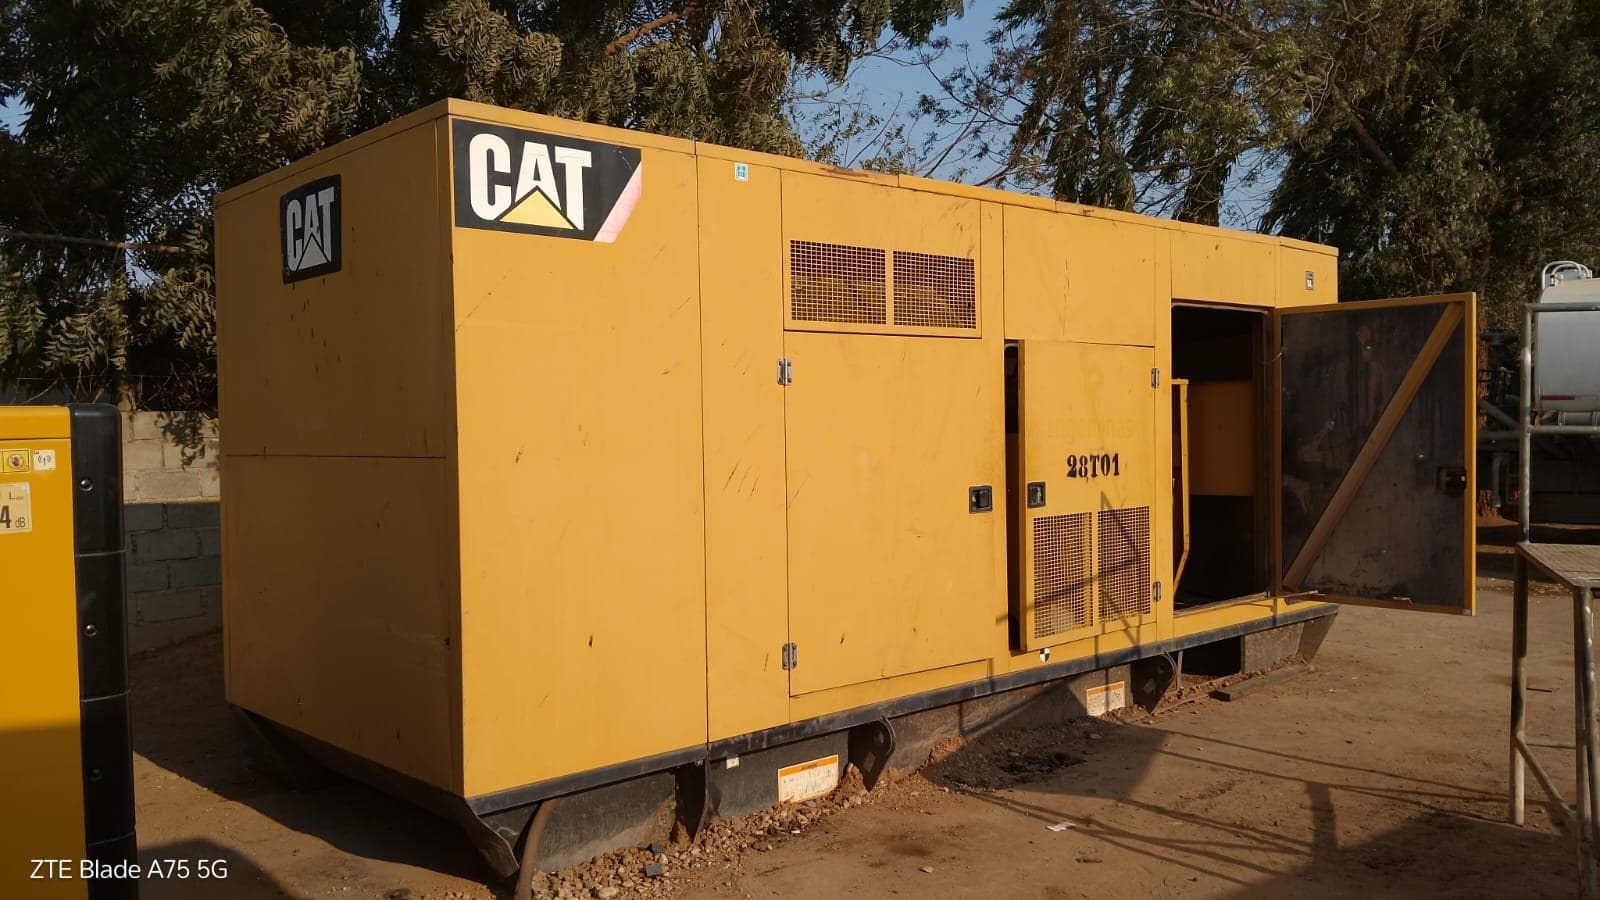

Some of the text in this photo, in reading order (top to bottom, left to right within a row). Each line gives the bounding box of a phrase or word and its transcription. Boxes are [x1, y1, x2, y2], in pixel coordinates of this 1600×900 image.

[470, 133, 592, 231] CAT
[286, 187, 335, 272] CAT
[1066, 453, 1120, 478] 28T01
[15, 516, 26, 528] dB
